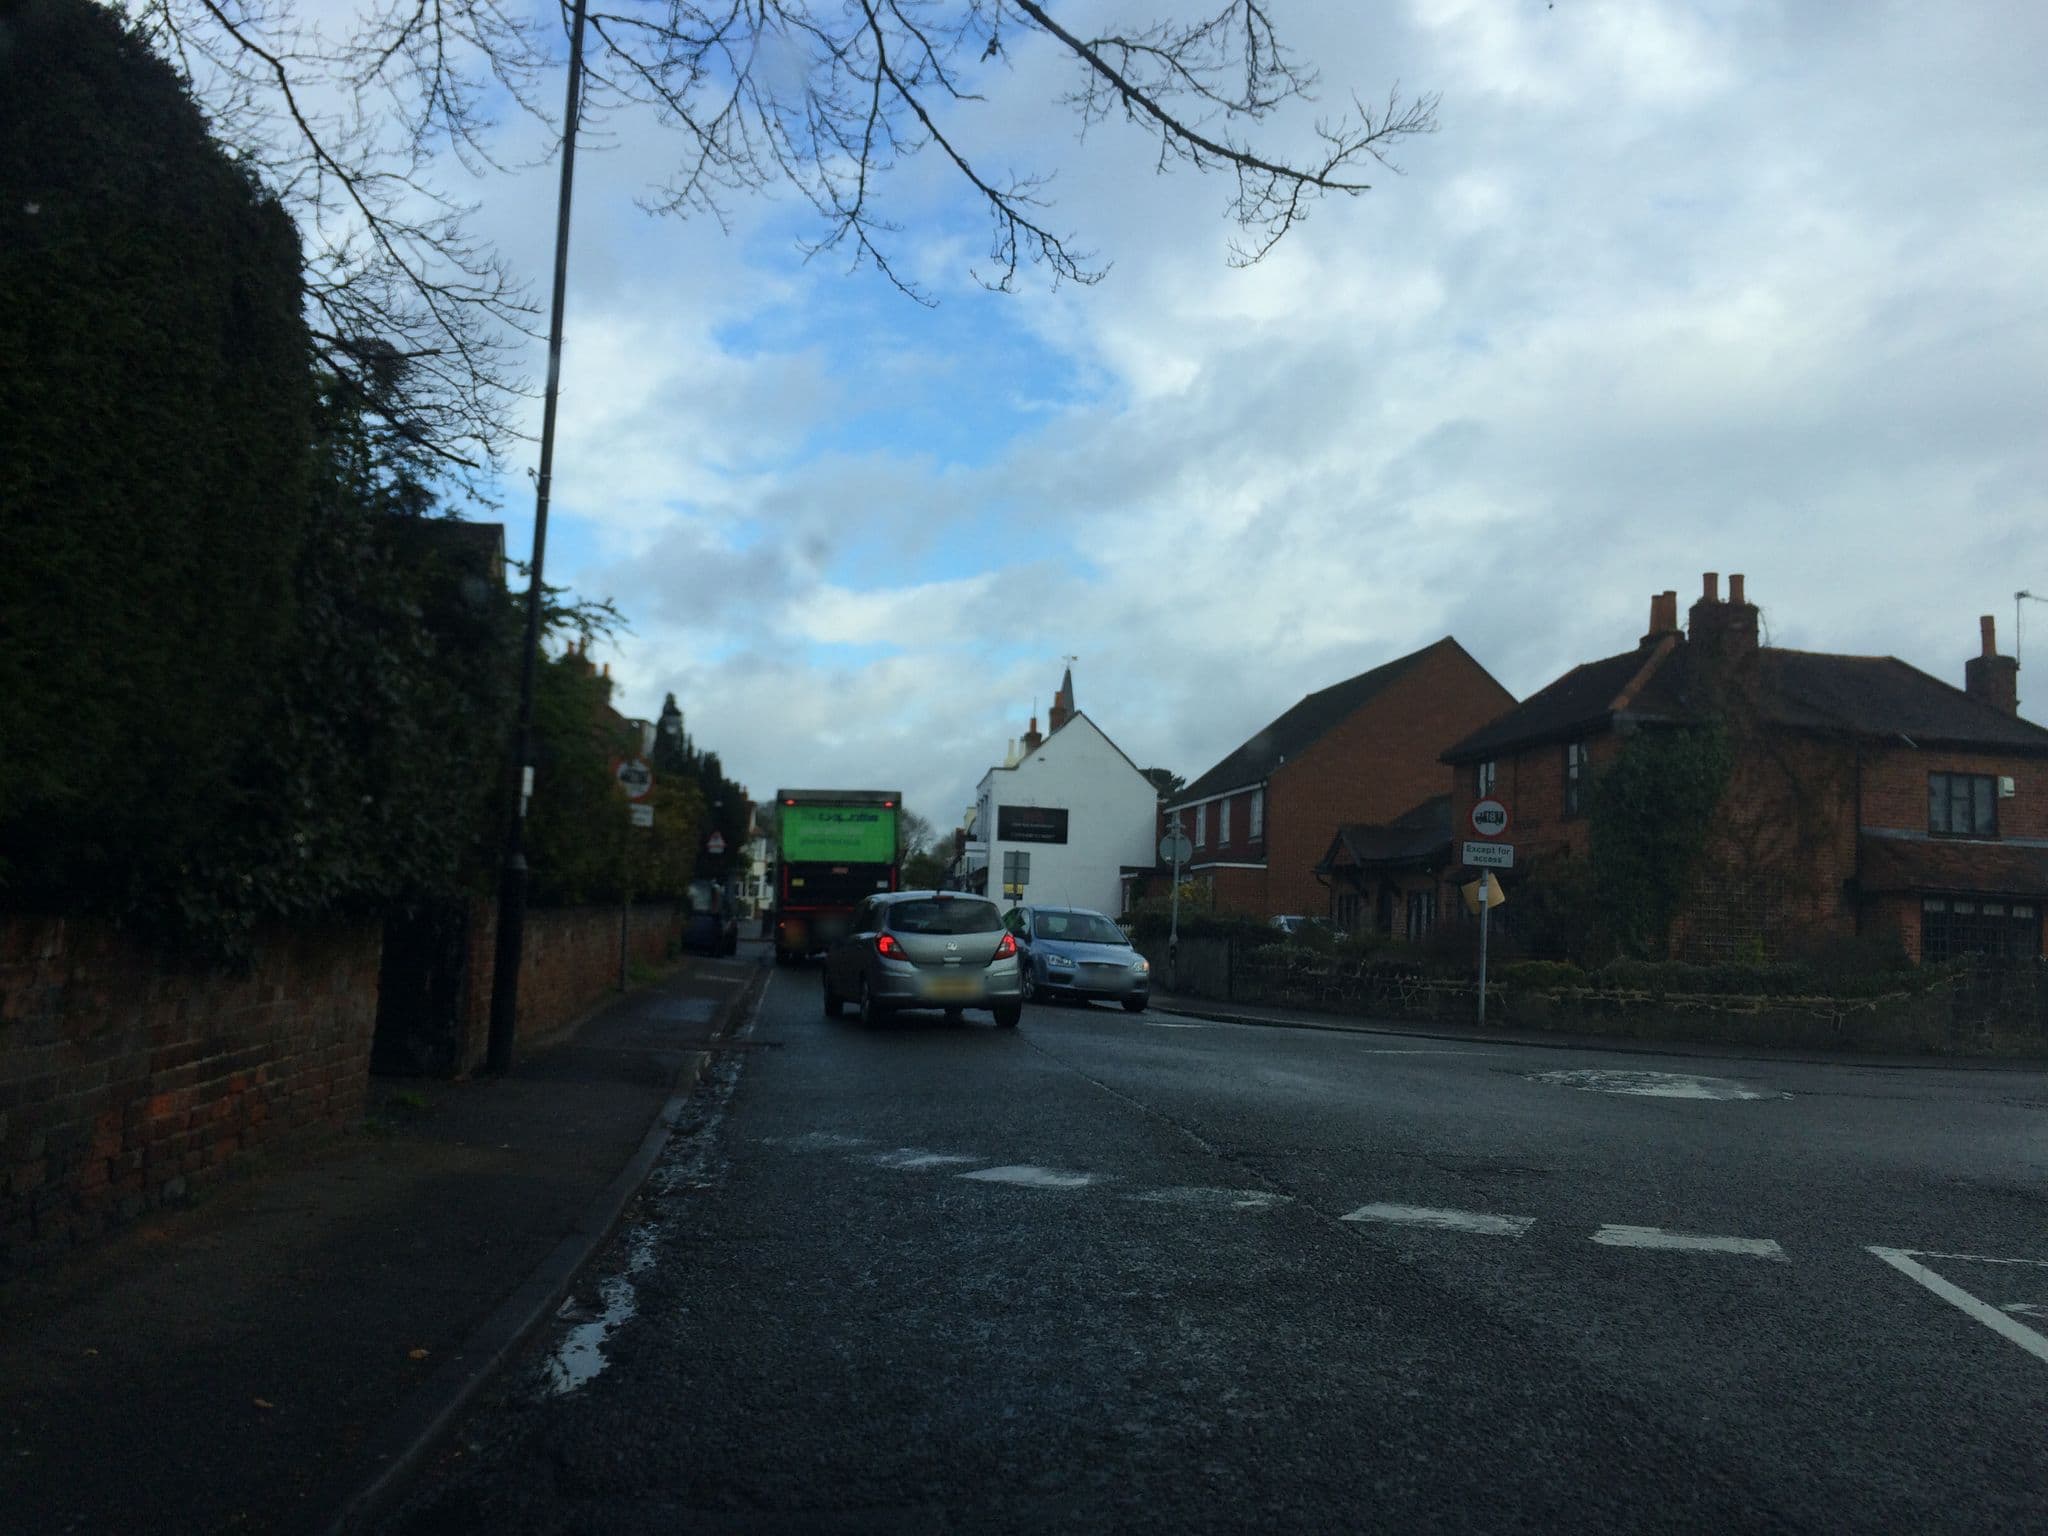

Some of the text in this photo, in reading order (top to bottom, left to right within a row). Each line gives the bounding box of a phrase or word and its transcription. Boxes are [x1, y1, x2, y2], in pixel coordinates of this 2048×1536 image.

[1466, 844, 1511, 855] Except for
[1473, 856, 1502, 864] access
